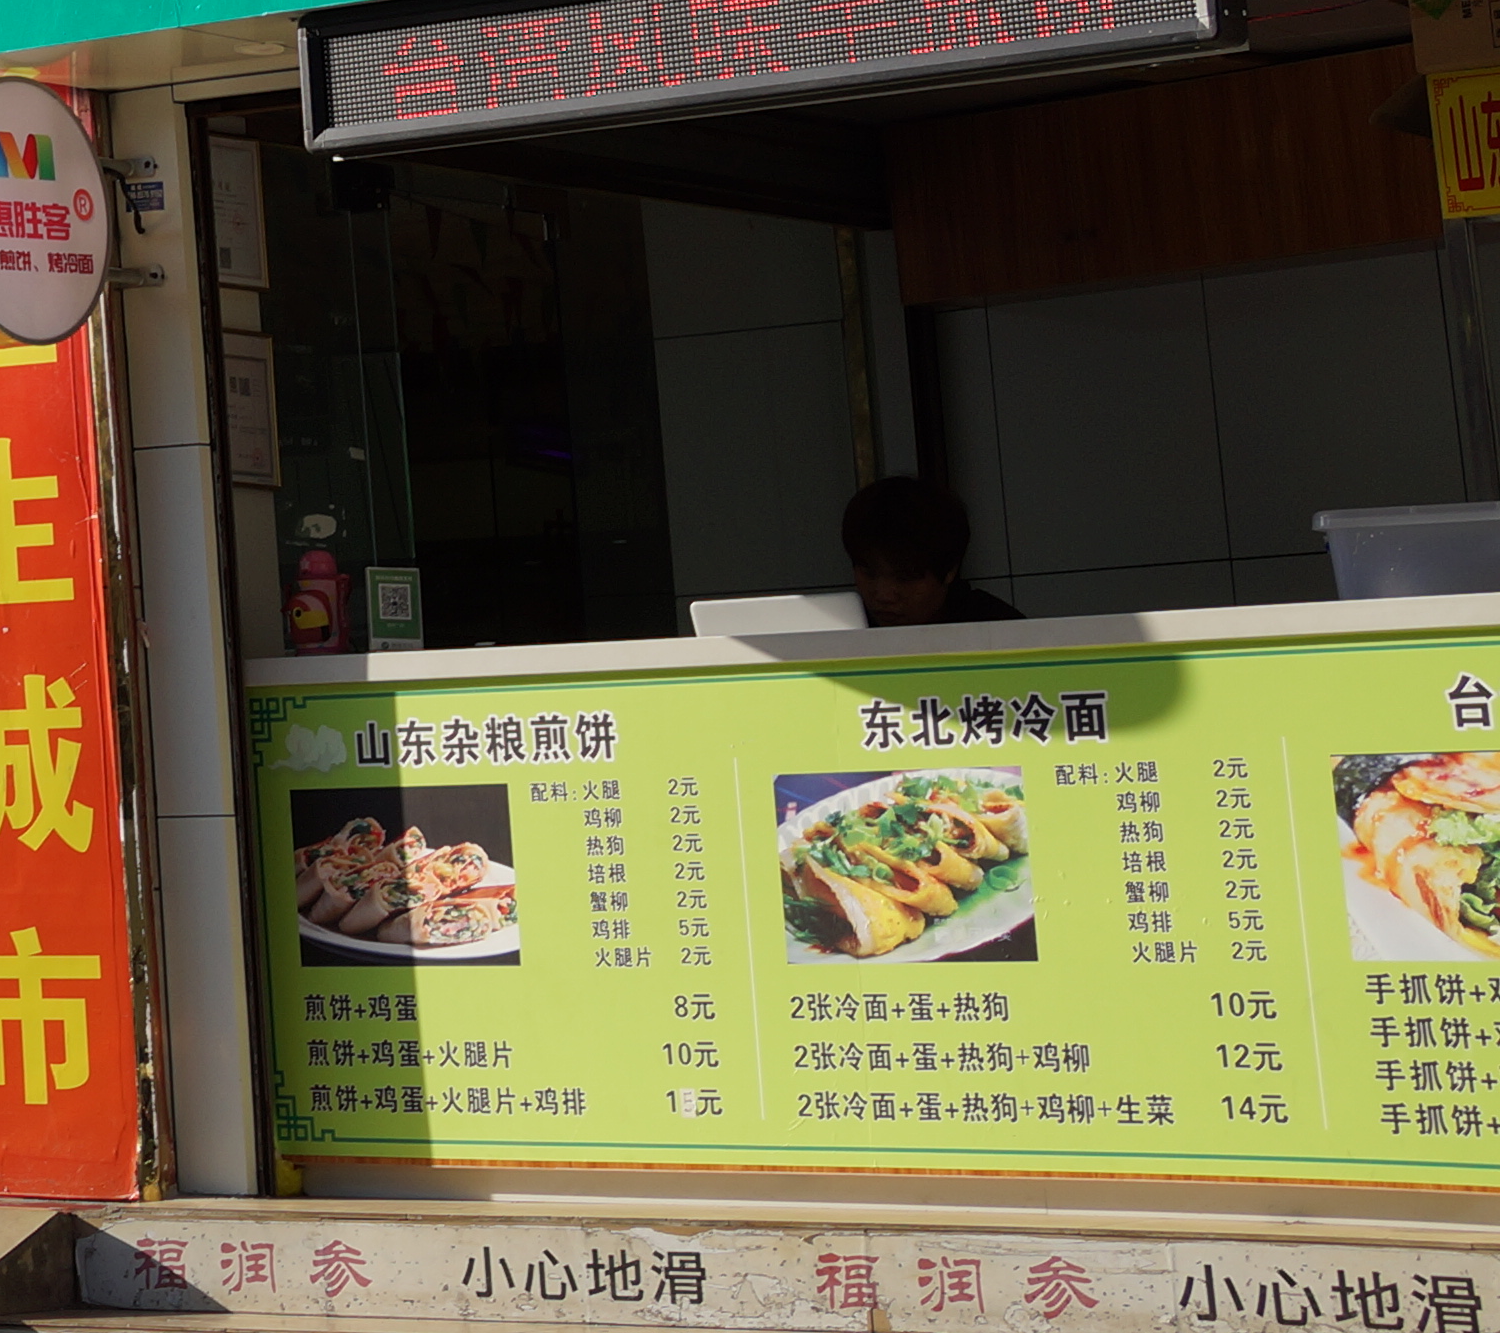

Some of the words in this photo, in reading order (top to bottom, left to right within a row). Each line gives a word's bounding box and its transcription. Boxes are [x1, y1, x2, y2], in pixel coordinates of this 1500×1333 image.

[860, 691, 1108, 749] 东北烤冷面
[354, 711, 619, 768] 山东杂粮煎饼
[1054, 760, 1160, 787] 配料:火腿
[1212, 758, 1250, 780] 2元
[529, 777, 621, 803] 配料:火腿
[667, 777, 700, 798] 2元
[1116, 790, 1162, 815] 鸡柳
[1216, 787, 1253, 811] 2元
[583, 805, 623, 829] 鸡柳
[669, 804, 702, 826] 2元
[1118, 820, 1165, 843] 热狗
[1218, 818, 1255, 840] 2元
[585, 834, 626, 856] 热狗
[670, 833, 704, 854] 2元
[587, 861, 628, 884] 培根
[672, 860, 706, 882] 2元
[1121, 848, 1168, 873] 培根
[1222, 847, 1258, 871] 2元
[590, 890, 630, 912] 蟹柳
[675, 889, 708, 910] 2元
[1124, 879, 1171, 903] 蟹柳
[1224, 878, 1261, 901] 2元
[592, 917, 632, 939] 鸡排
[677, 916, 711, 937] 5元
[1127, 909, 1173, 934] 鸡排
[1228, 908, 1265, 932] 5元
[594, 946, 653, 968] 火腿片
[680, 945, 713, 967] 2元
[1132, 938, 1198, 965] 火腿片
[1230, 938, 1268, 963] 2元
[303, 991, 419, 1023] 煎饼+鸡蛋
[673, 992, 717, 1022] 8元
[789, 991, 1010, 1024] 2张冷面+蛋+热狗
[1210, 989, 1278, 1022] 10元
[306, 1038, 515, 1071] 煎饼+鸡蛋+火腿片
[662, 1039, 721, 1068] 10元
[793, 1040, 1091, 1075] 2张冷面+蛋+热狗+鸡柳
[1215, 1040, 1284, 1074] 12元
[309, 1085, 588, 1117] 煎饼+鸡蛋+火腿片+鸡排
[796, 1091, 1176, 1127] 2张冷面+蛋+热狗+鸡柳+生菜
[1220, 1092, 1290, 1125] 14元
[134, 1235, 374, 1299] 福润参
[458, 1246, 709, 1311] 小心地滑
[815, 1249, 1102, 1321] 福润参
[1176, 1263, 1485, 1333] 小心地滑
